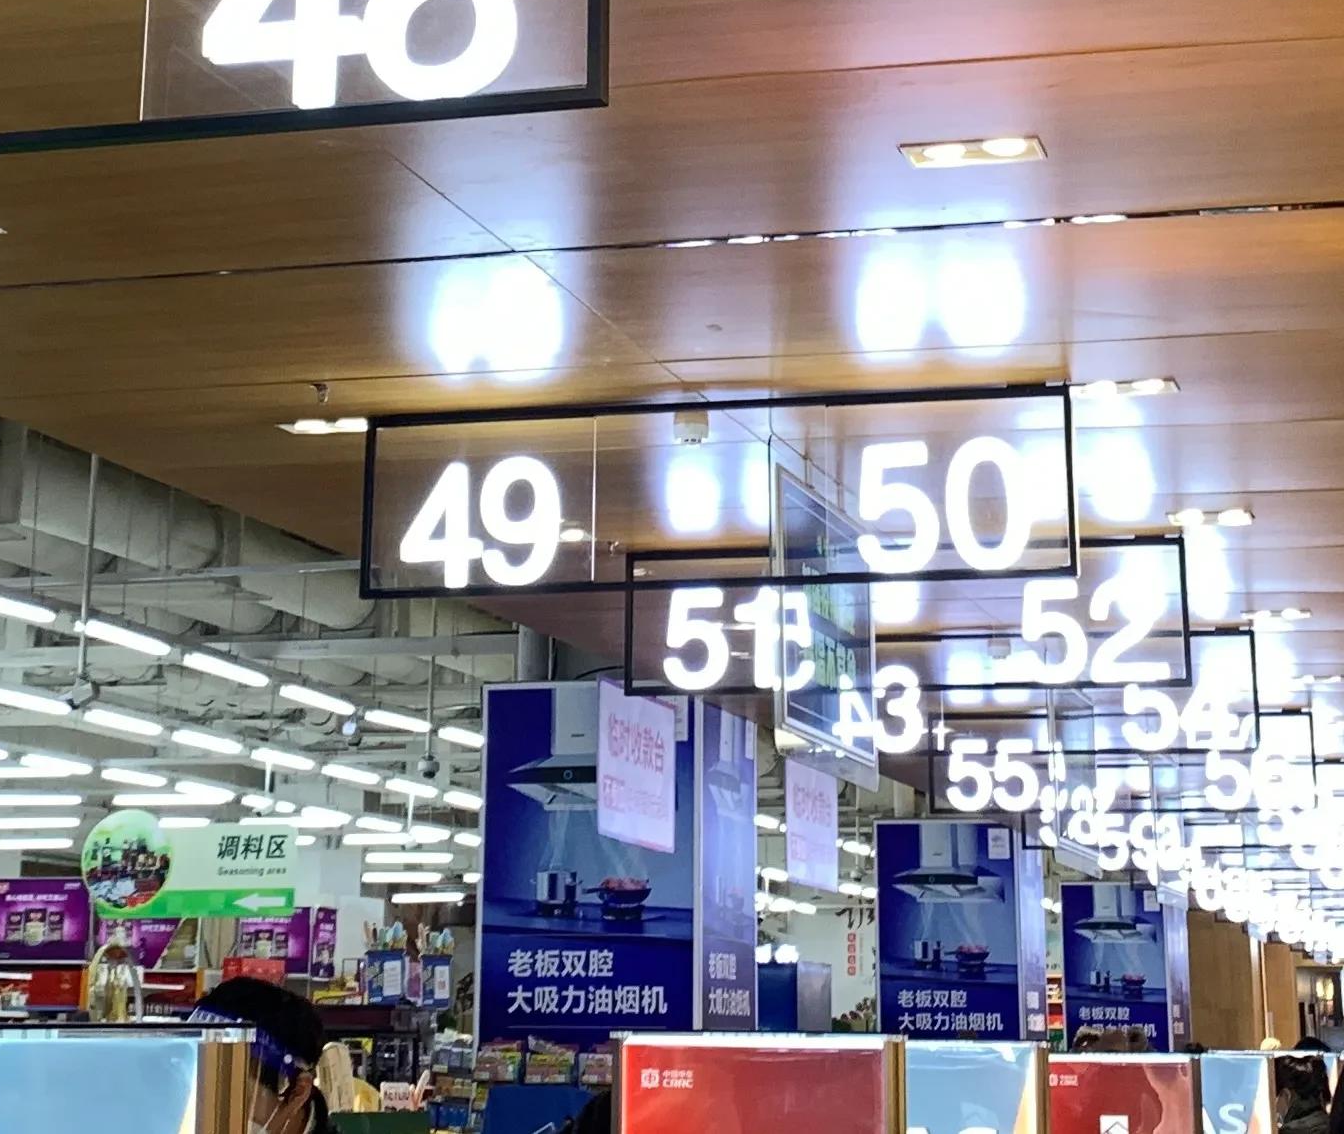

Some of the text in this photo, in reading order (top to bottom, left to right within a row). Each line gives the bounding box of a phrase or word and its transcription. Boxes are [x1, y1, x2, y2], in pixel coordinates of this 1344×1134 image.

[856, 435, 1033, 574] 50
[399, 456, 562, 589] 49
[1021, 577, 1171, 684] 52
[945, 738, 1040, 812] 55
[216, 834, 289, 861] 调料区
[507, 948, 615, 978] 老板双腔
[507, 984, 669, 1015] 大吸力油烟机
[897, 989, 968, 1009] 老板双腔
[897, 1012, 1005, 1032] 大吸力油烟机
